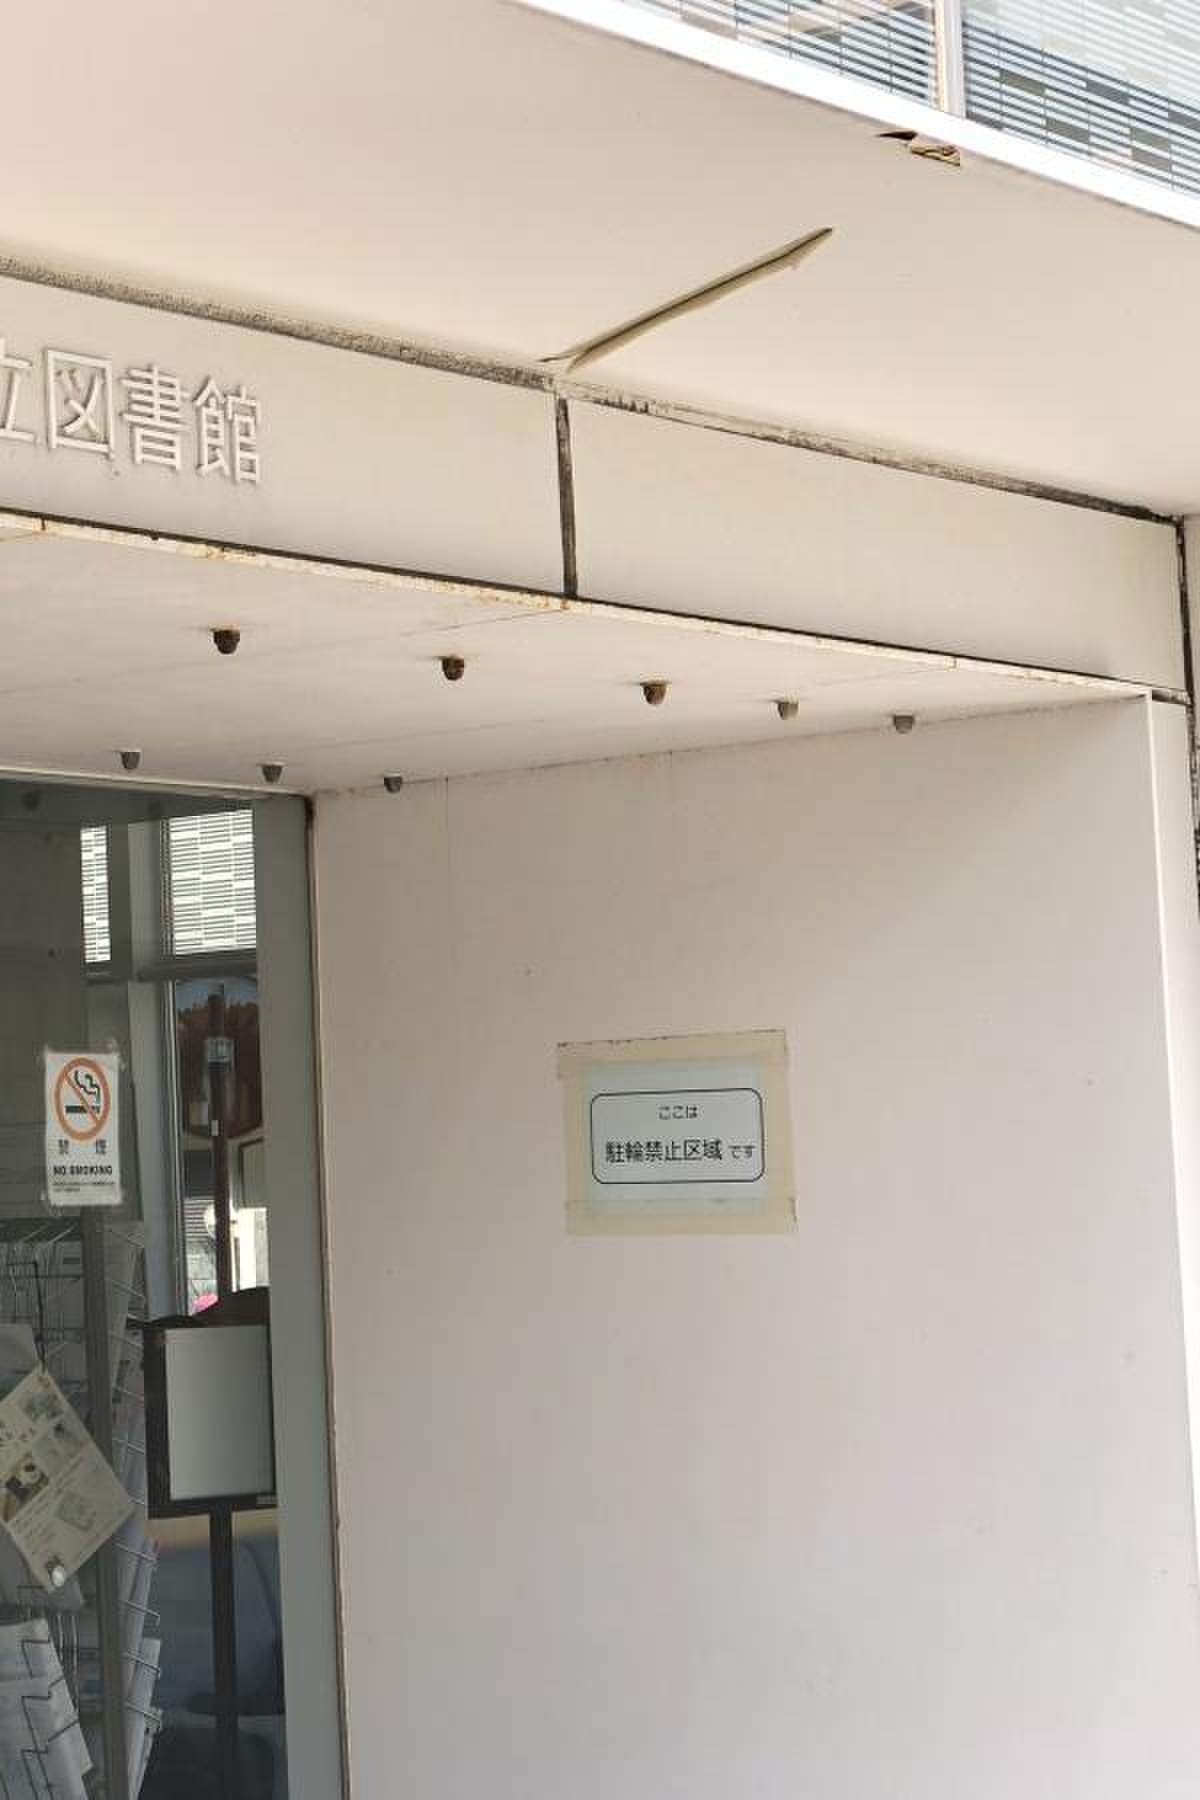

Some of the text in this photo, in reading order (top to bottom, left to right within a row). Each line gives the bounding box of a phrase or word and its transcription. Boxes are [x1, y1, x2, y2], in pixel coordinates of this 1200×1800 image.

[658, 1104, 699, 1121] ここは
[605, 1139, 756, 1164] 駐輪禁止区域 です
[53, 1165, 113, 1176] NO SMOKING
